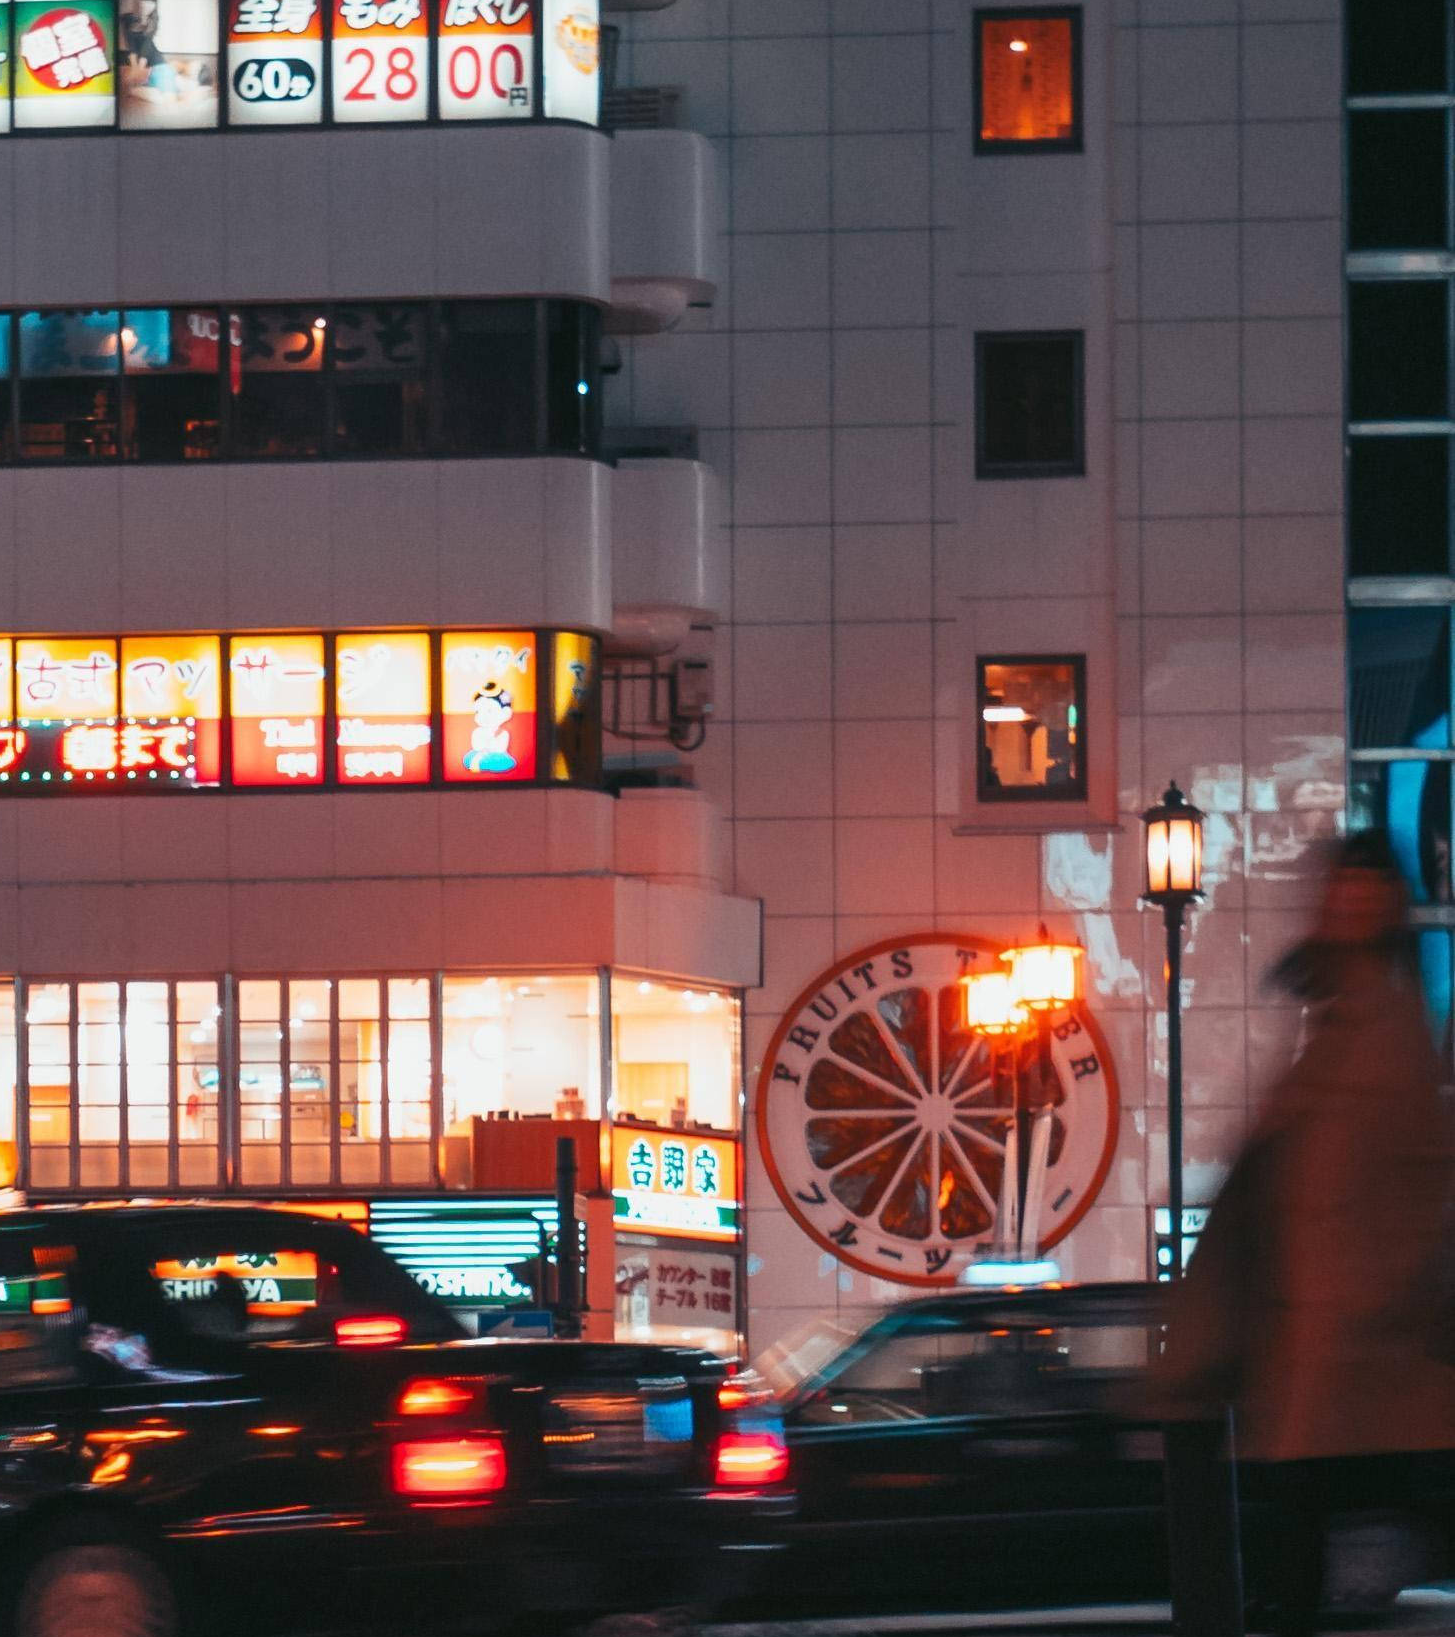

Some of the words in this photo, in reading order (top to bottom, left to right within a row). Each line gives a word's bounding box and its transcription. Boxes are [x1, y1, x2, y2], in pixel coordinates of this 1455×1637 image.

[771, 947, 916, 1086] FRUITS
[629, 1142, 718, 1193] 吉野家
